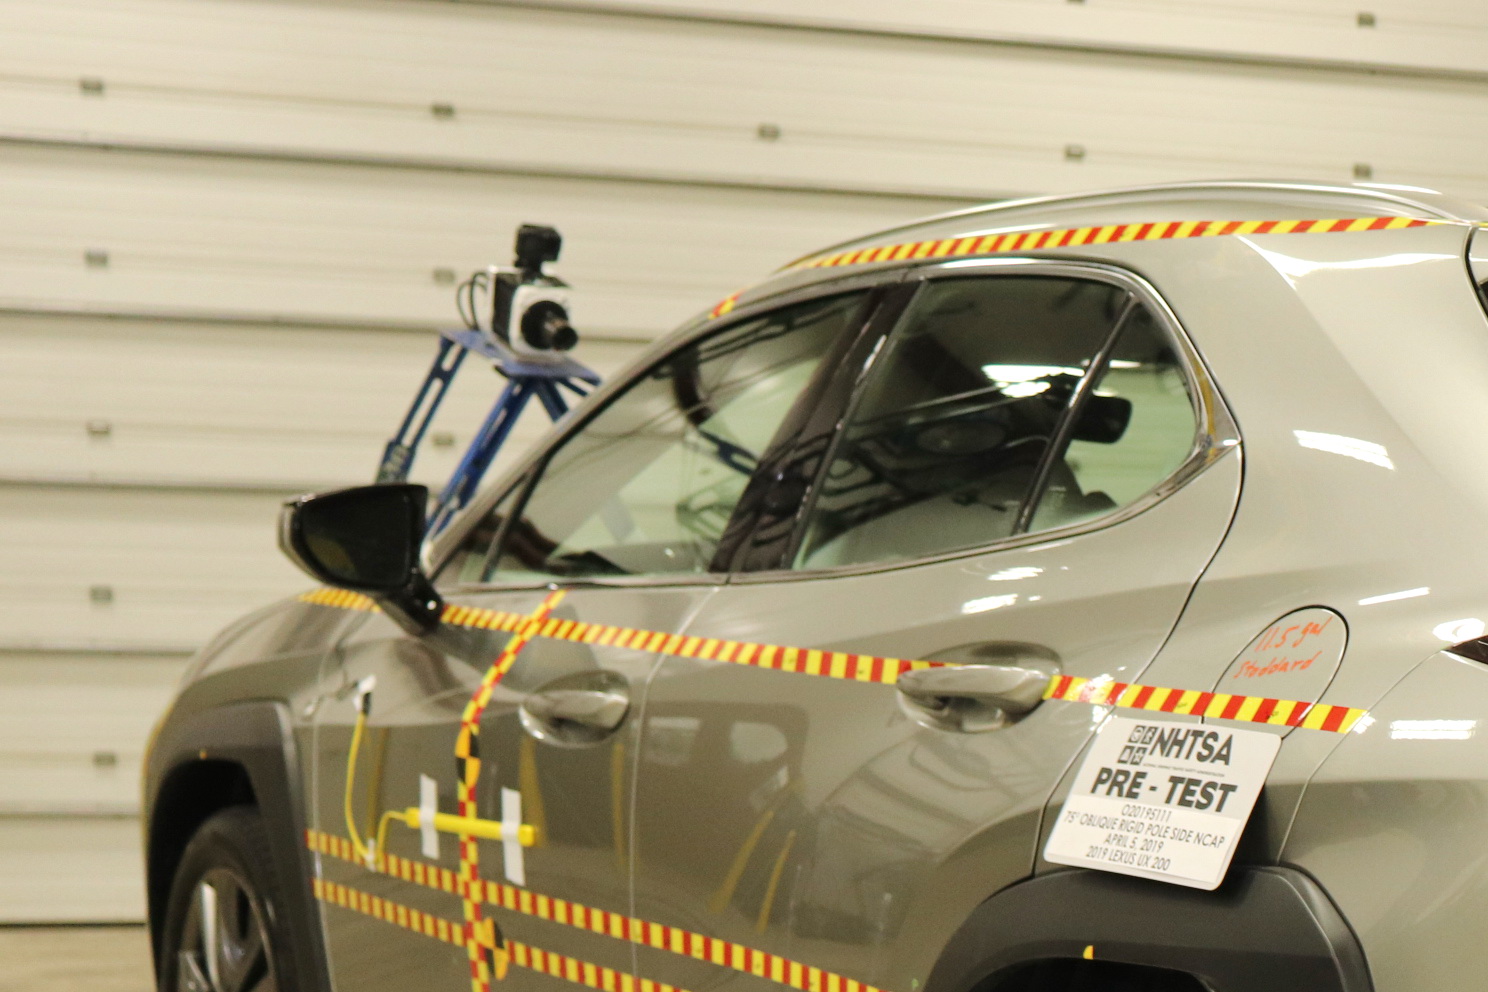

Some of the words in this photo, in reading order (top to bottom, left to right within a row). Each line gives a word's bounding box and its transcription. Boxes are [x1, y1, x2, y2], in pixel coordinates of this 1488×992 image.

[1149, 727, 1233, 766] NHTSA
[1090, 767, 1147, 799] PRE
[1165, 775, 1238, 813] TEST
[1080, 813, 1119, 830] OBLIQUE
[1118, 819, 1144, 834] RIGID
[1145, 823, 1170, 838] POLE
[1170, 827, 1194, 842] SIDE
[1194, 832, 1225, 848] NCAP
[1103, 833, 1128, 848] APRIL
[1140, 838, 1164, 853] 2019
[1086, 845, 1108, 860] 2019
[1108, 849, 1136, 865] LEXUS
[1137, 854, 1152, 867] UX
[1151, 856, 1171, 871] 200
